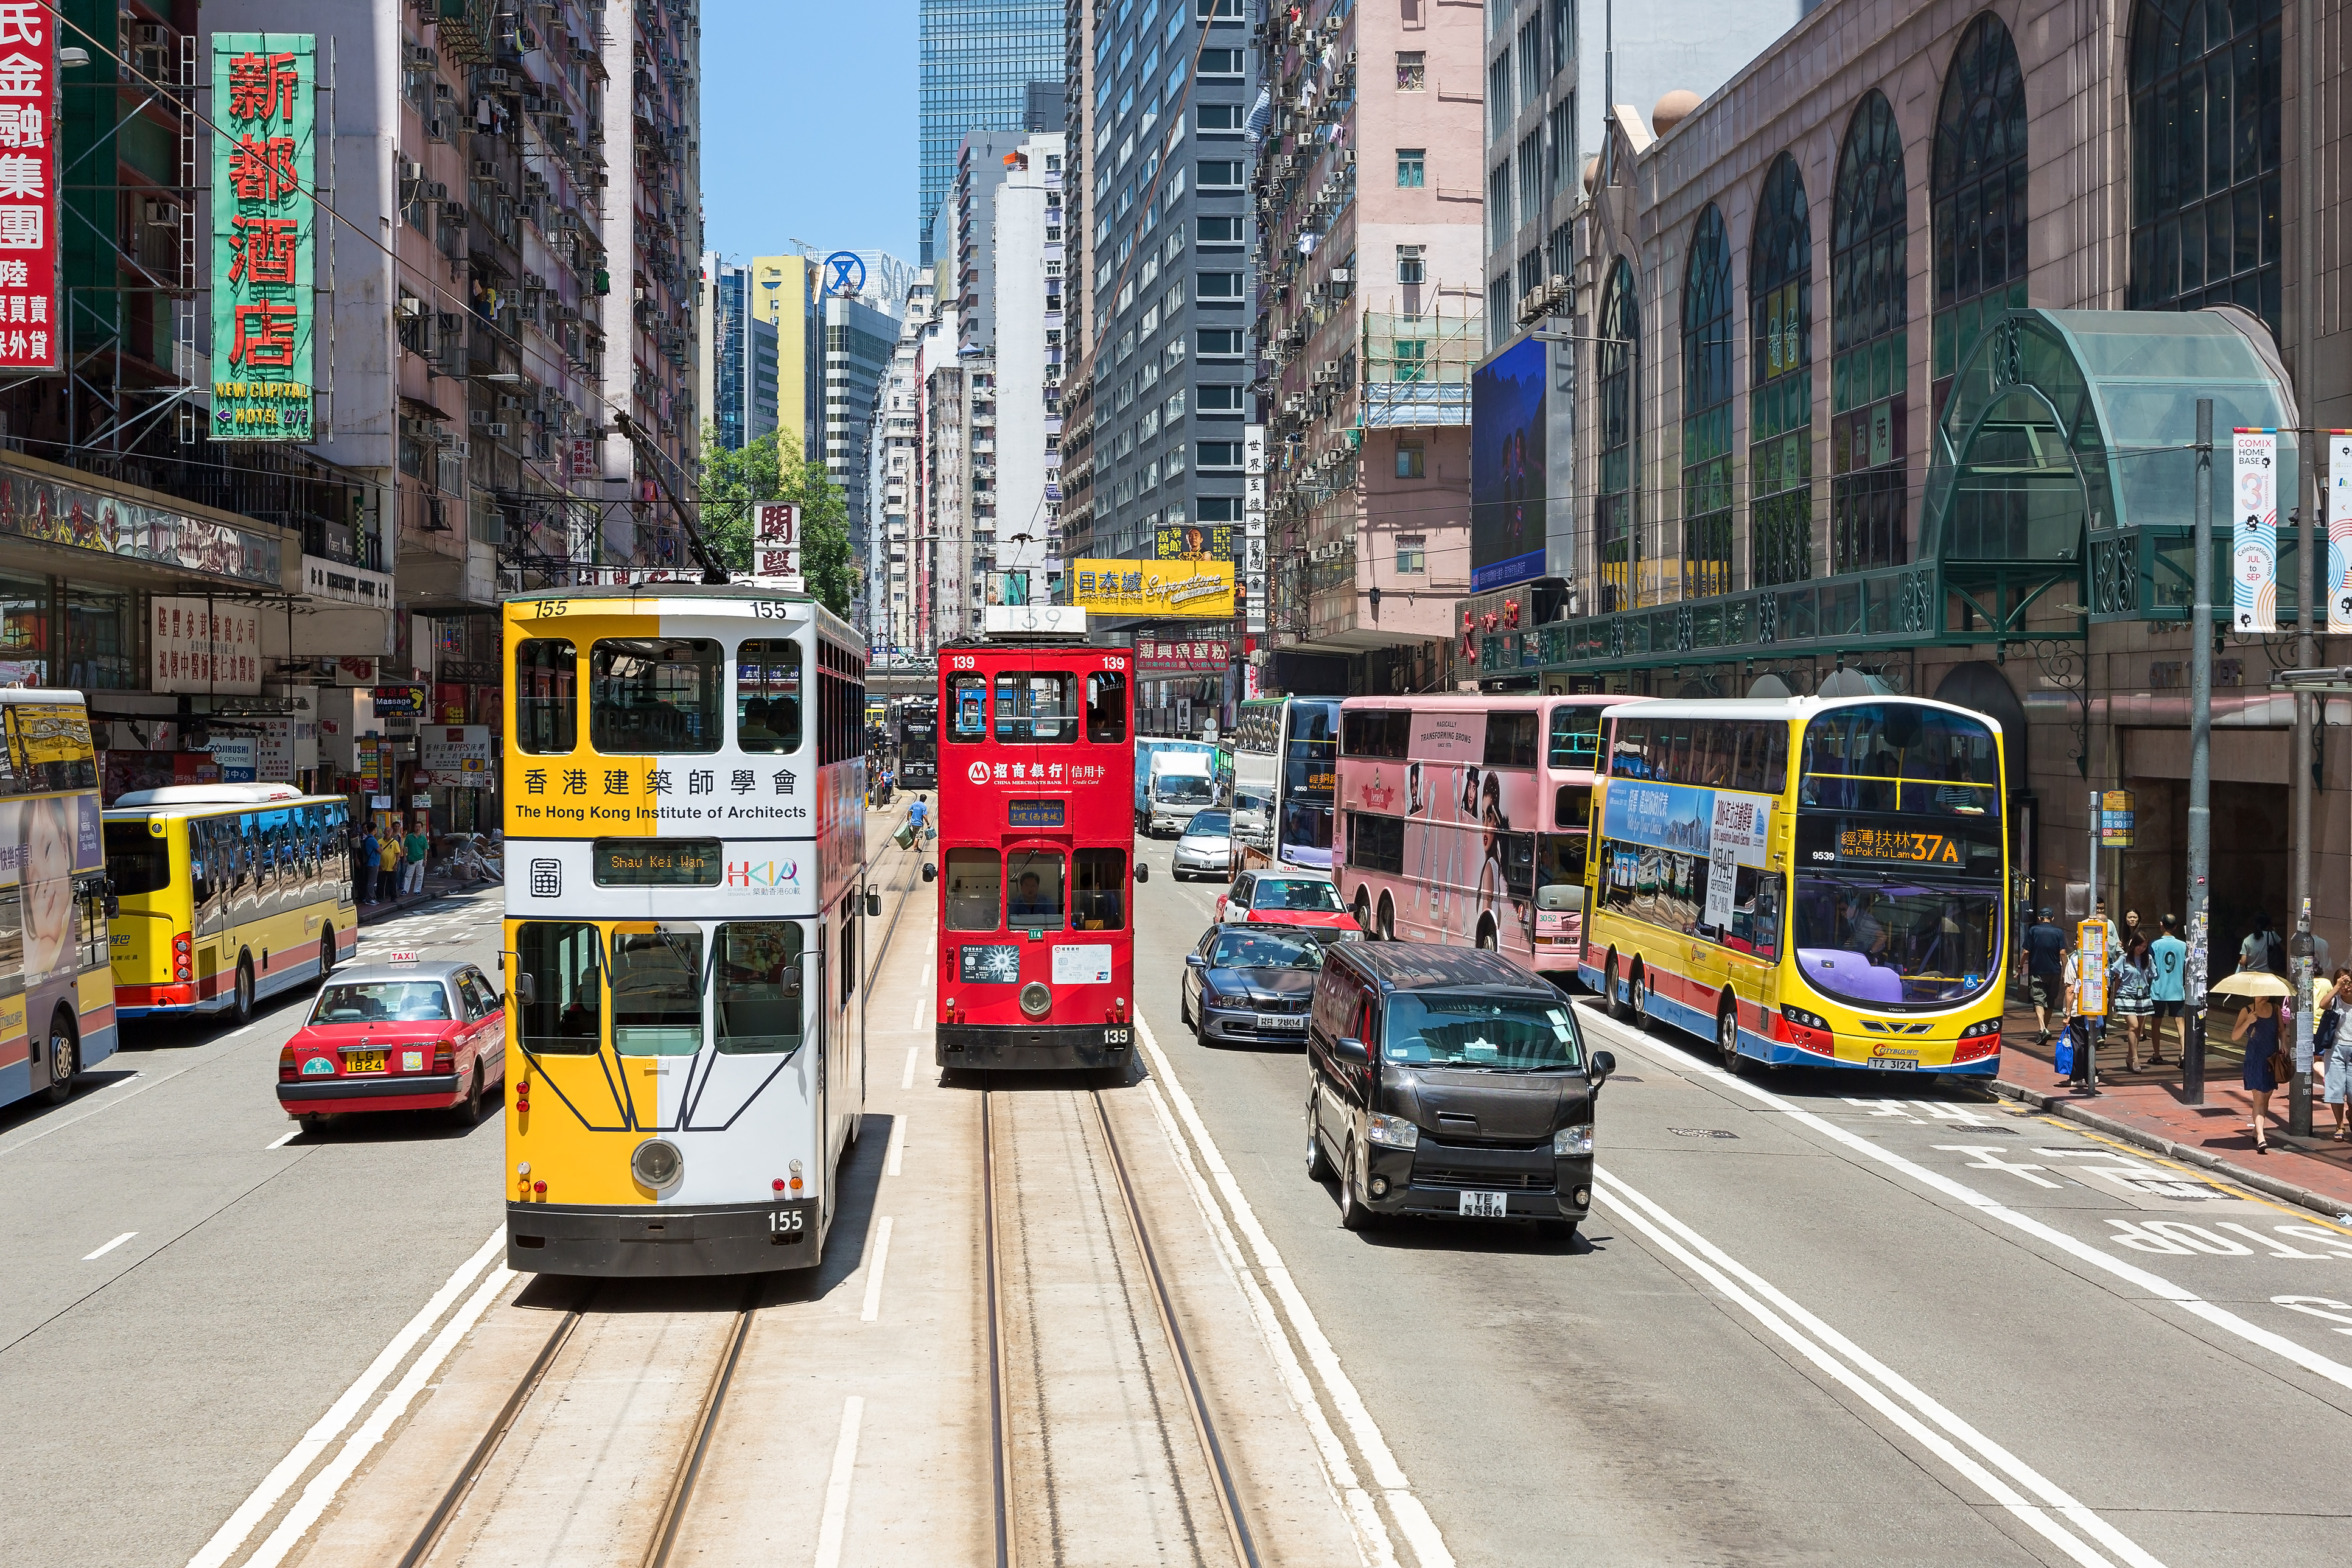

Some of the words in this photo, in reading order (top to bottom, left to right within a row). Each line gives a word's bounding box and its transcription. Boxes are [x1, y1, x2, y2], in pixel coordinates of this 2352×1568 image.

[229, 51, 298, 367] 新都酒店
[216, 382, 246, 399] NEW
[250, 382, 309, 399] CAPITAL
[236, 408, 278, 425] HOTEL
[284, 408, 308, 424] 2/F
[2238, 439, 2272, 448] COMIX
[573, 440, 584, 475] 黃錦華
[2239, 457, 2260, 465] BASE
[2241, 472, 2263, 510] 3
[2237, 545, 2270, 561] Celebrations
[1079, 570, 1142, 592] 日本城
[1145, 573, 1222, 602] Superstore
[534, 600, 568, 618] 155
[749, 601, 787, 620] 155
[1009, 608, 1062, 630] 139
[1139, 642, 1227, 660] 潮興魚蛋粉
[951, 656, 975, 669] 139
[1102, 656, 1125, 670] 139
[1421, 731, 1454, 742] TRANSFORMING
[1455, 732, 1472, 744] BROWS
[208, 743, 249, 755] ZOJIRUSHI
[993, 762, 1063, 779] 招商銀行
[1071, 765, 1106, 779] 信用卡
[523, 768, 799, 796] 香港建築師學會
[1010, 801, 1037, 810] Western
[1039, 801, 1062, 810] Market
[1639, 790, 1669, 818] 選出你的代表
[516, 805, 542, 818] The
[546, 805, 584, 821] Hong
[590, 805, 631, 822] Kong
[636, 804, 702, 819] Institute
[707, 805, 724, 819] of
[727, 805, 807, 819] Architects
[1715, 799, 1754, 833] 2016年立法會選舉
[1740, 833, 1751, 847] Election
[1841, 830, 1910, 849] 經薄扶林
[1911, 833, 1959, 863] 37A
[1812, 851, 1835, 861] 9539
[1841, 848, 1854, 858] via
[1855, 846, 1873, 858] Pok
[1875, 846, 1888, 858] Fu
[1889, 846, 1910, 858] Lam
[611, 856, 645, 868] Shau
[649, 856, 673, 868] Kei
[680, 856, 704, 868] Wan
[1712, 847, 1735, 883] 9月4日
[728, 858, 801, 887] HKIA
[752, 887, 801, 896] 築動香港60載
[1710, 878, 1729, 893] SEPTEMBER
[1729, 886, 1732, 894] 4
[391, 952, 414, 961] TAXI
[2165, 951, 2176, 973] 9
[1259, 1017, 1275, 1027] RB
[1276, 1017, 1303, 1027] 2804
[1104, 1029, 1129, 1043] 139
[356, 1052, 374, 1061] LG
[1878, 1046, 1906, 1056] CITYBUS
[349, 1060, 382, 1071] 1824
[1872, 1059, 1885, 1069] TZ
[1889, 1058, 1913, 1069] 3124
[1475, 1192, 1493, 1205] TE
[1463, 1205, 1503, 1217] 5586
[768, 1211, 803, 1232] 155
